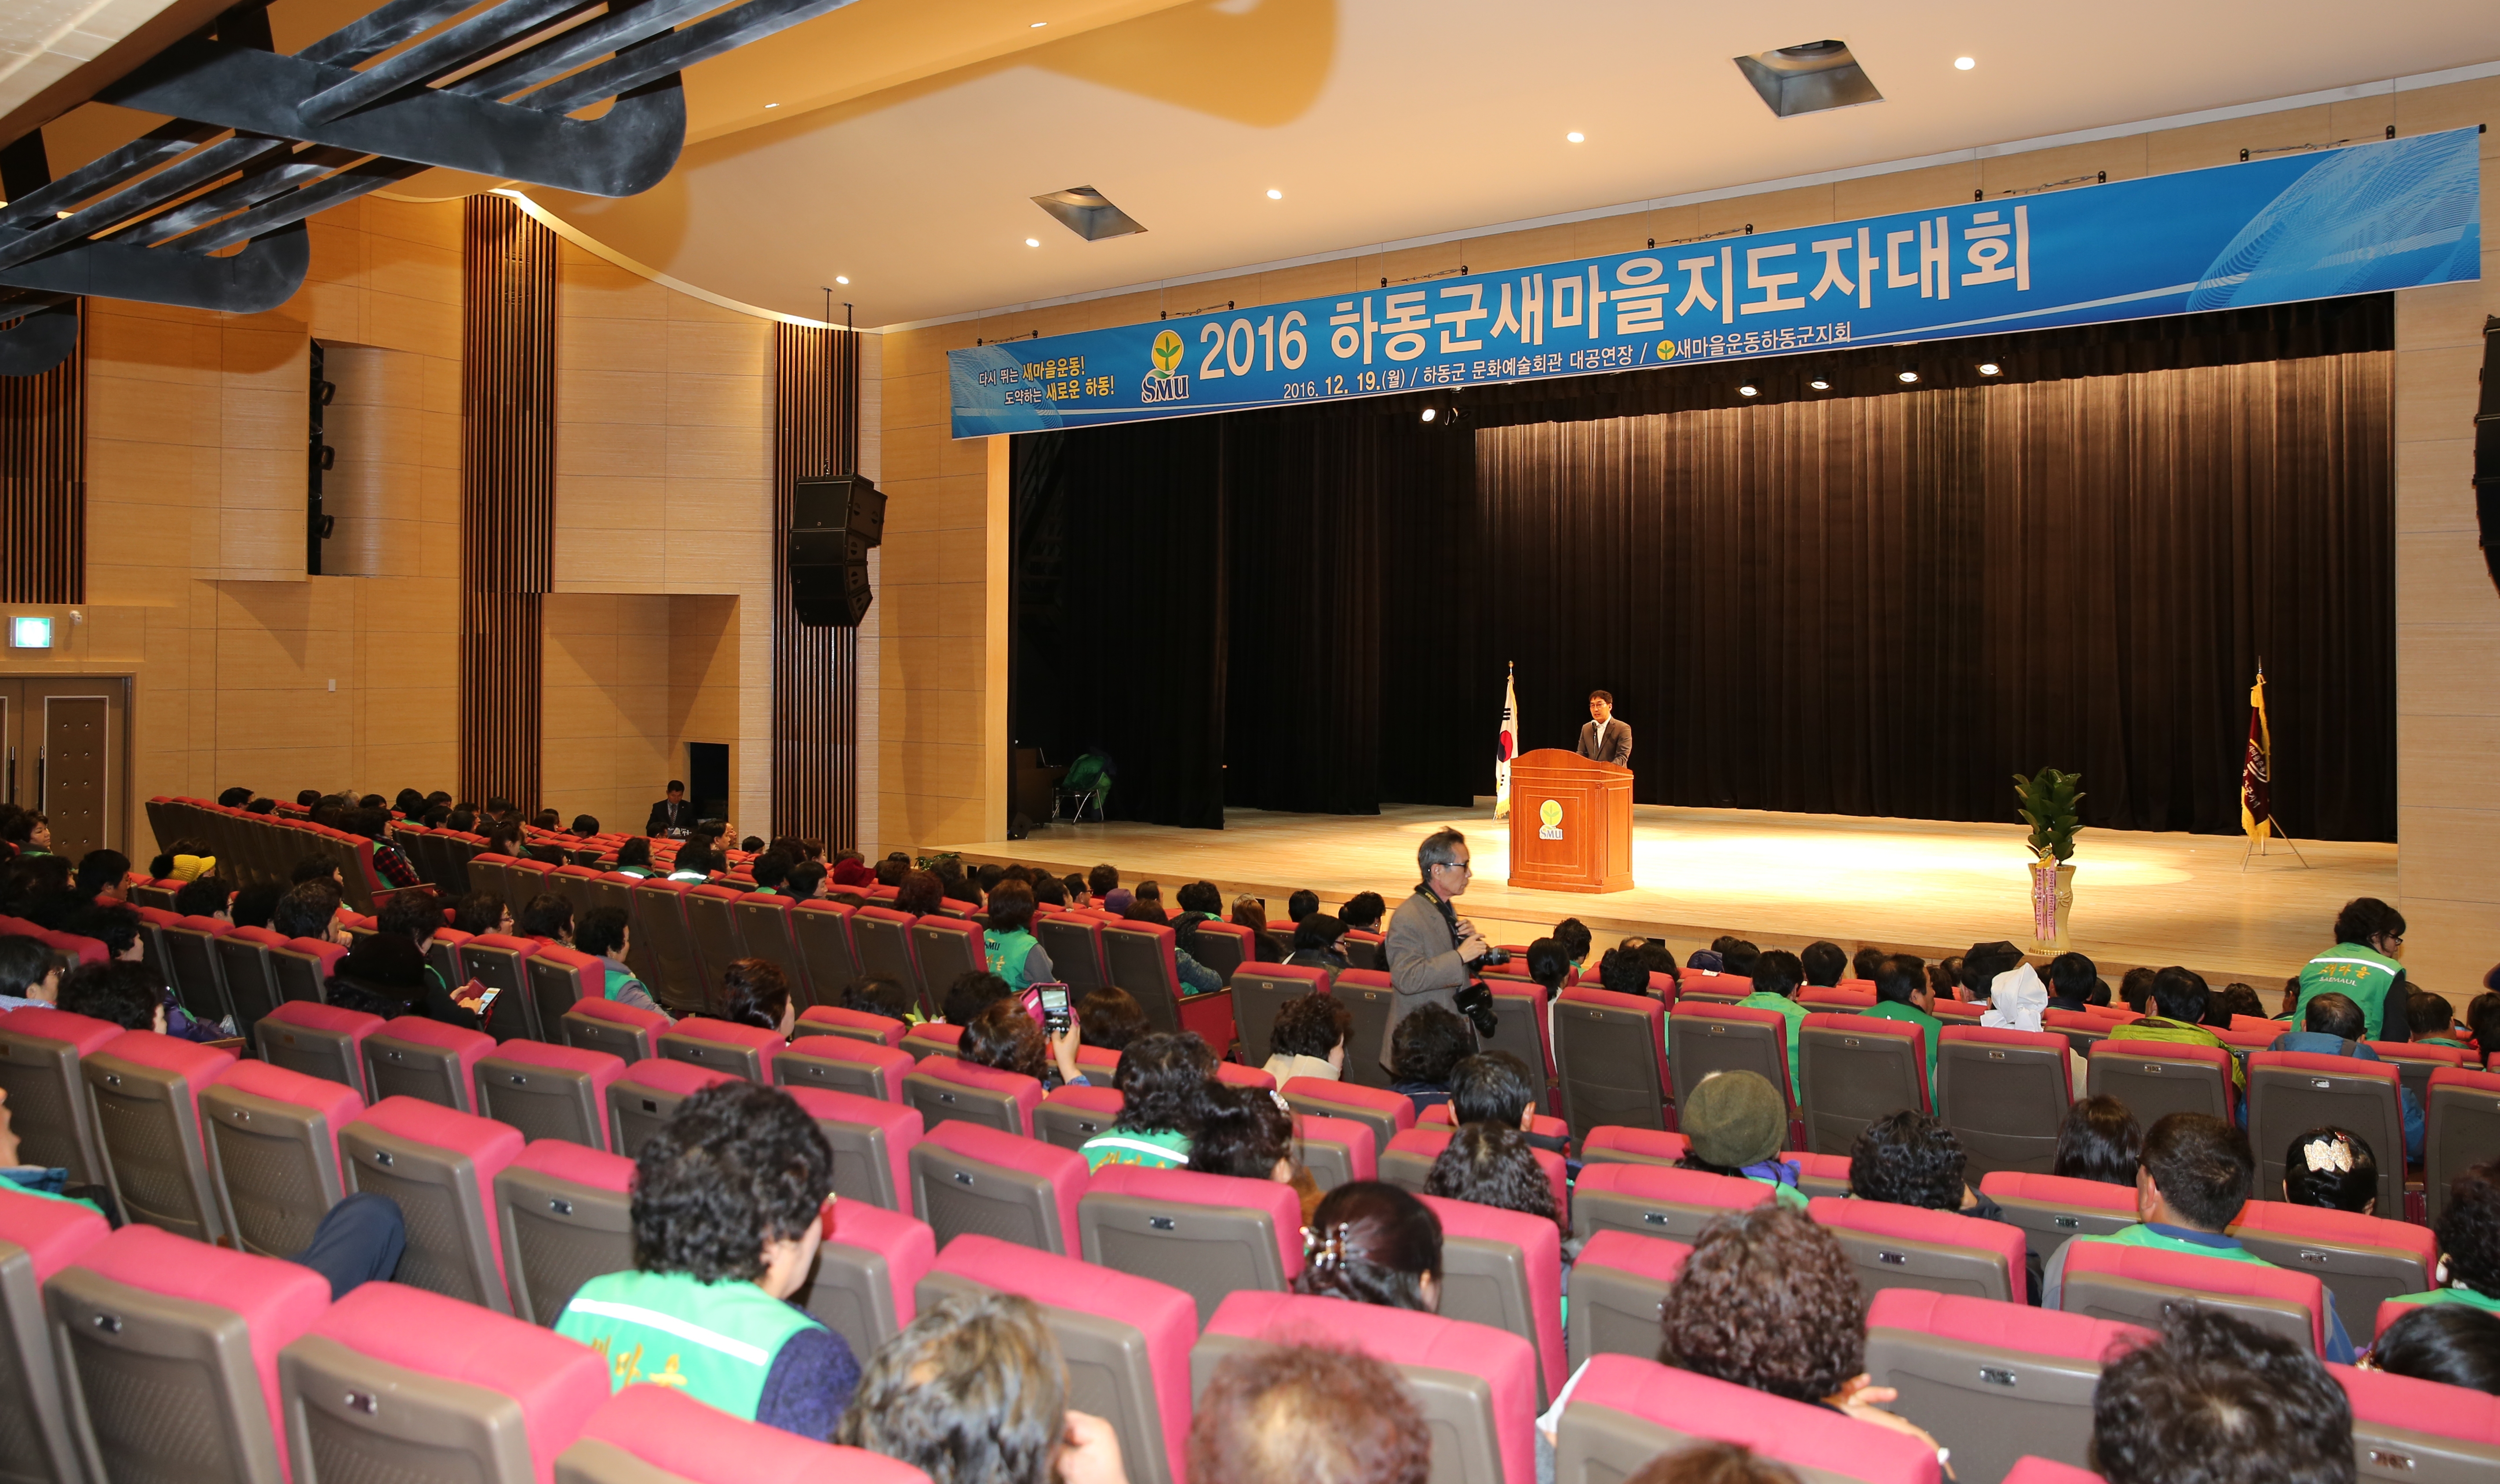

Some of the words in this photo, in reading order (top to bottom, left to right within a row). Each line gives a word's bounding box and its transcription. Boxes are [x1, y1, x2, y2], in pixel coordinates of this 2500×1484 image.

[1199, 310, 1308, 380] 2016
[1330, 205, 2030, 365] 하동군새마을지도자대회
[979, 368, 997, 387] 다시
[1000, 367, 1019, 384] 뛰는
[1022, 355, 1086, 382] 새마을운동!
[1283, 382, 1319, 399] 2016.
[1325, 375, 1349, 395] 12.
[1423, 363, 1466, 384] 하동군
[1471, 352, 1563, 379] 문화예술회관
[1570, 345, 1633, 370] 대공연장
[1675, 321, 1852, 359] 새마을운동하동군지회
[1004, 386, 1042, 405] 도약하는
[1046, 380, 1081, 402] 새로운
[1085, 375, 1115, 397] 하동!
[1142, 371, 1189, 403] SMU
[1540, 826, 1563, 840] SMU
[986, 953, 1006, 971] 마을
[2318, 962, 2371, 979] 새마을
[2319, 976, 2357, 986] SAEMAUL
